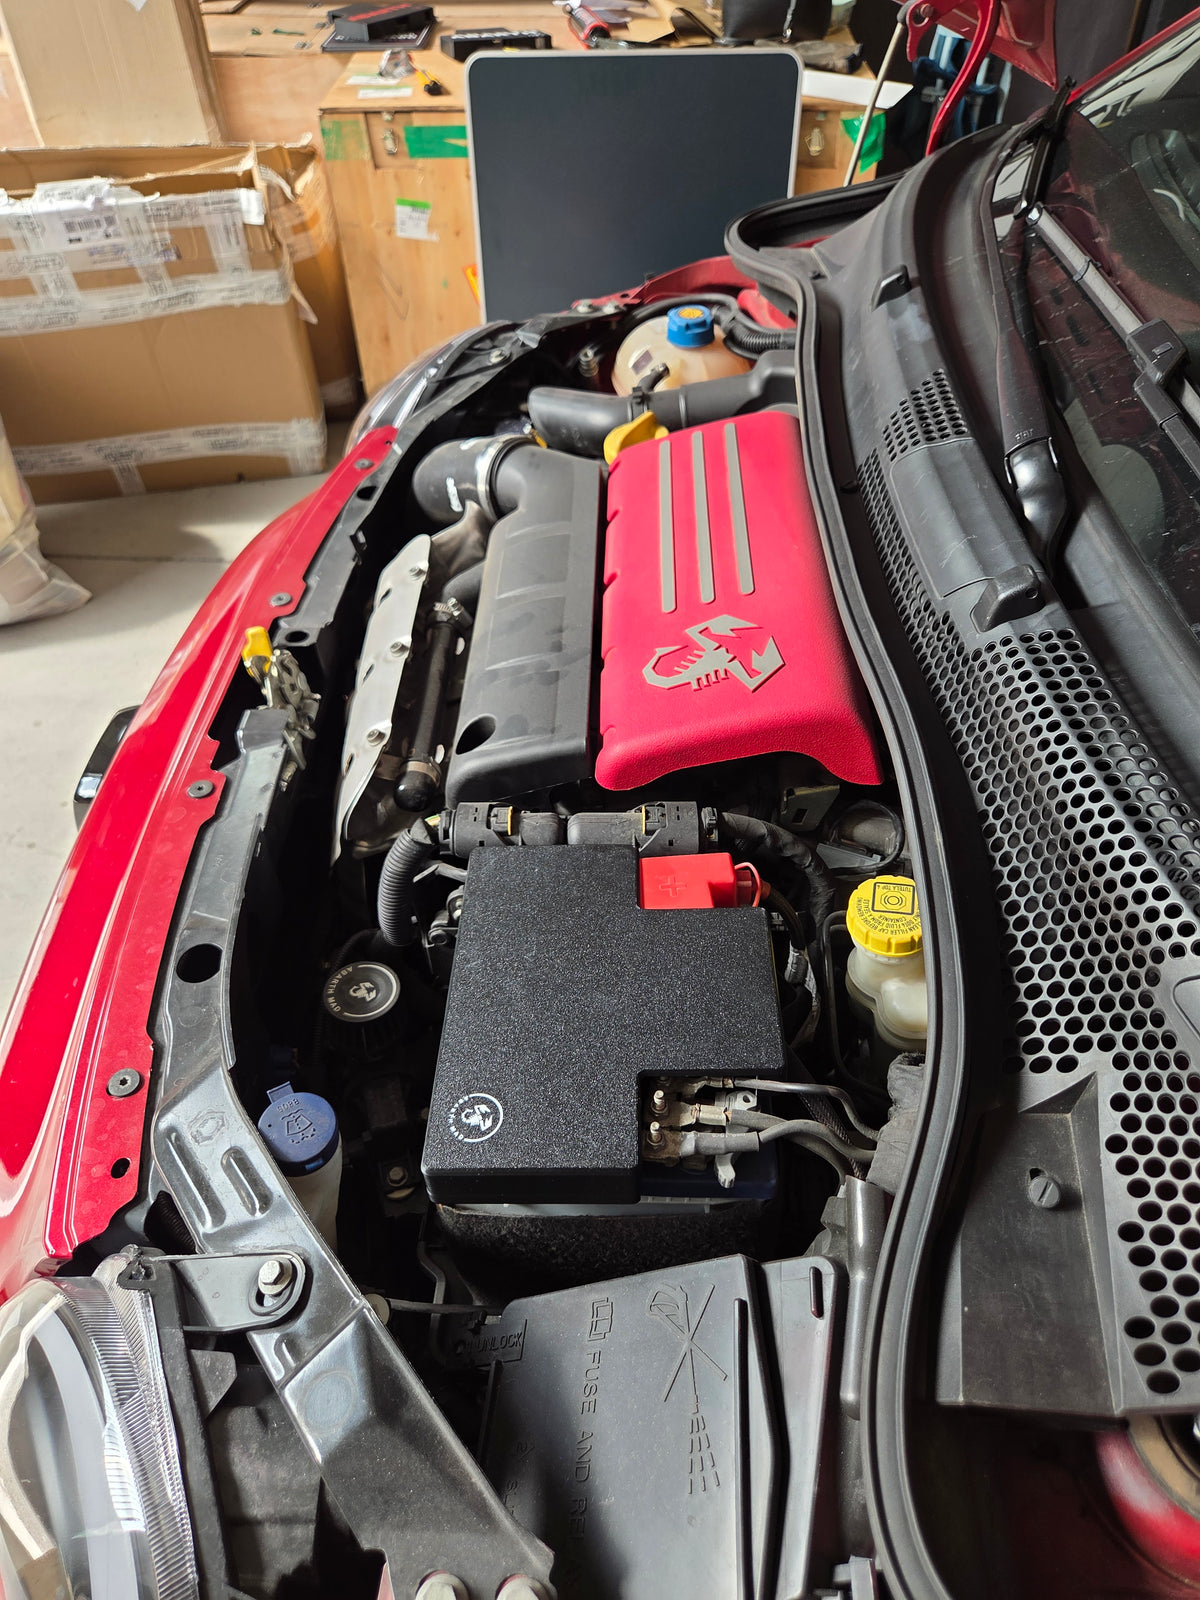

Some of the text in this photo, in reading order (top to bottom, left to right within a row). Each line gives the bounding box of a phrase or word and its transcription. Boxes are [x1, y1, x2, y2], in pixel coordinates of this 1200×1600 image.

[327, 965, 353, 994] ABARTH
[478, 1331, 523, 1353] UNLOCK
[580, 1349, 602, 1416] FUSE
[573, 1430, 595, 1483] AND
